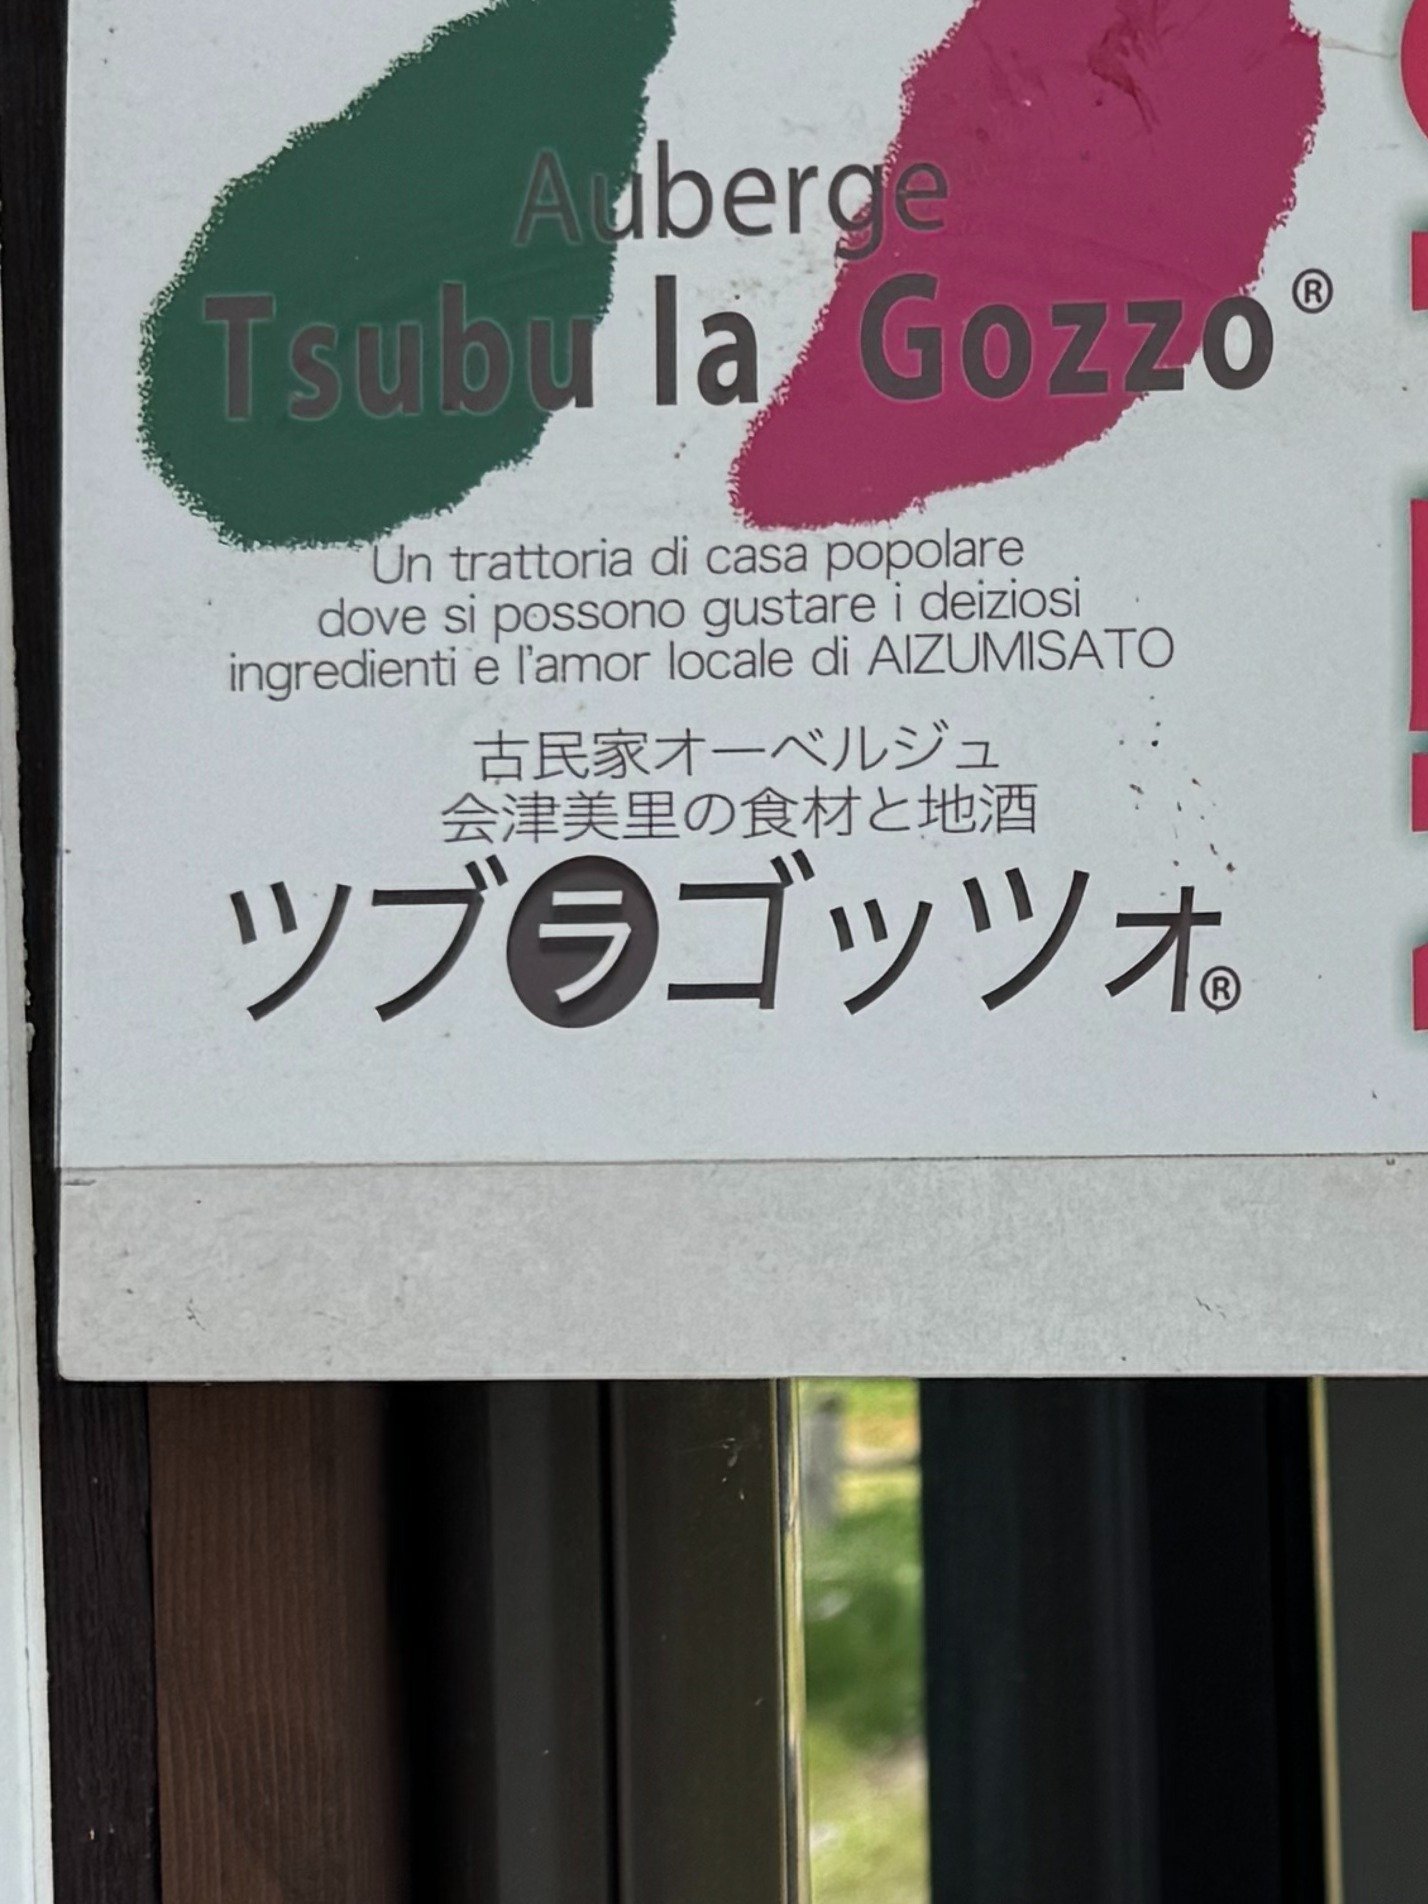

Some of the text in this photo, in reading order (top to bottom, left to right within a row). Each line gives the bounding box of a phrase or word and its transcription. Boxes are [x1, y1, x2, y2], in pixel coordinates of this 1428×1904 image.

[514, 140, 951, 260] Auberge
[204, 282, 595, 422] Tsubu
[654, 274, 760, 408] la
[372, 527, 1025, 584] Un trattoria di casa popolare
[317, 578, 1082, 645] dove si possono gustare i deiziosi
[229, 626, 1175, 703] ingredienti e l'amor locale di AIZUMISATO
[472, 718, 1001, 783] 古民家オーベルジュ
[440, 782, 1040, 845] 会津美里の食材と地酒
